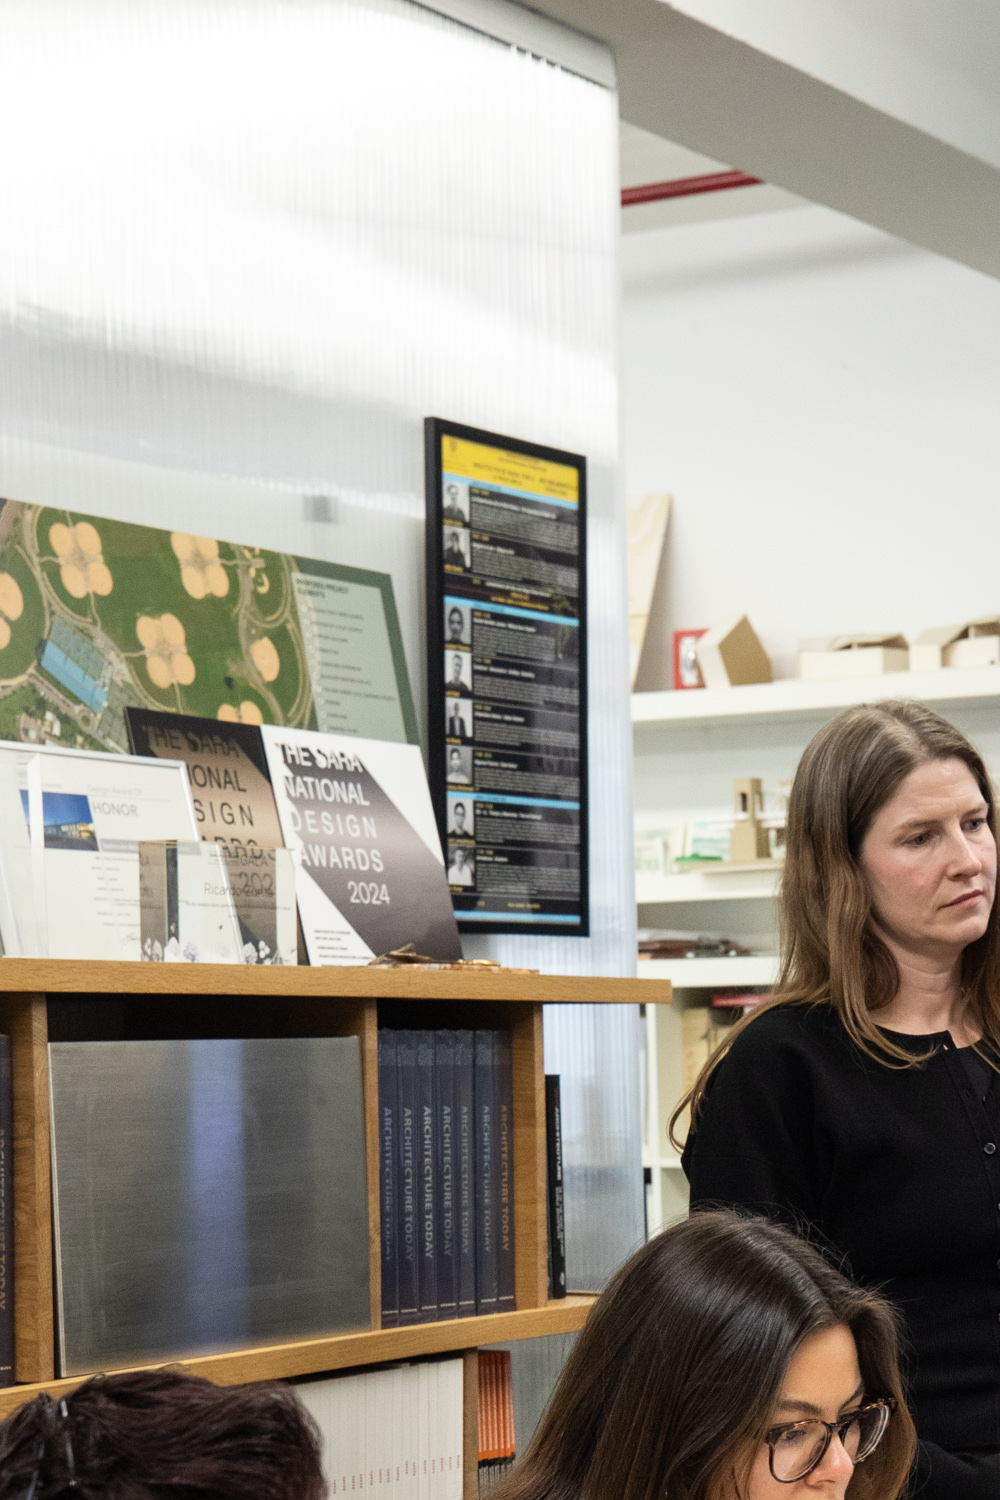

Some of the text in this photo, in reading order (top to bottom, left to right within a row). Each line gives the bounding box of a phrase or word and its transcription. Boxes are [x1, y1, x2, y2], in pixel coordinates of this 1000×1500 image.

[314, 749, 364, 774] SARA
[188, 764, 247, 793] IONAL
[284, 775, 370, 806] NATIONAL
[93, 802, 139, 817] HONOR
[195, 799, 255, 827] SIGN
[291, 808, 377, 839] DESIGN
[300, 842, 384, 873] AWARDS
[347, 881, 391, 906] 2024
[482, 1105, 492, 1205] ARCHITECTURE
[403, 1108, 415, 1262] ARCHITECTURE TODAY
[423, 1106, 434, 1259] ARCHITECTURE TODAY
[442, 1105, 452, 1257] ARCHITECTURE TODAY
[500, 1104, 510, 1252] ARCHITECTURE TODAY
